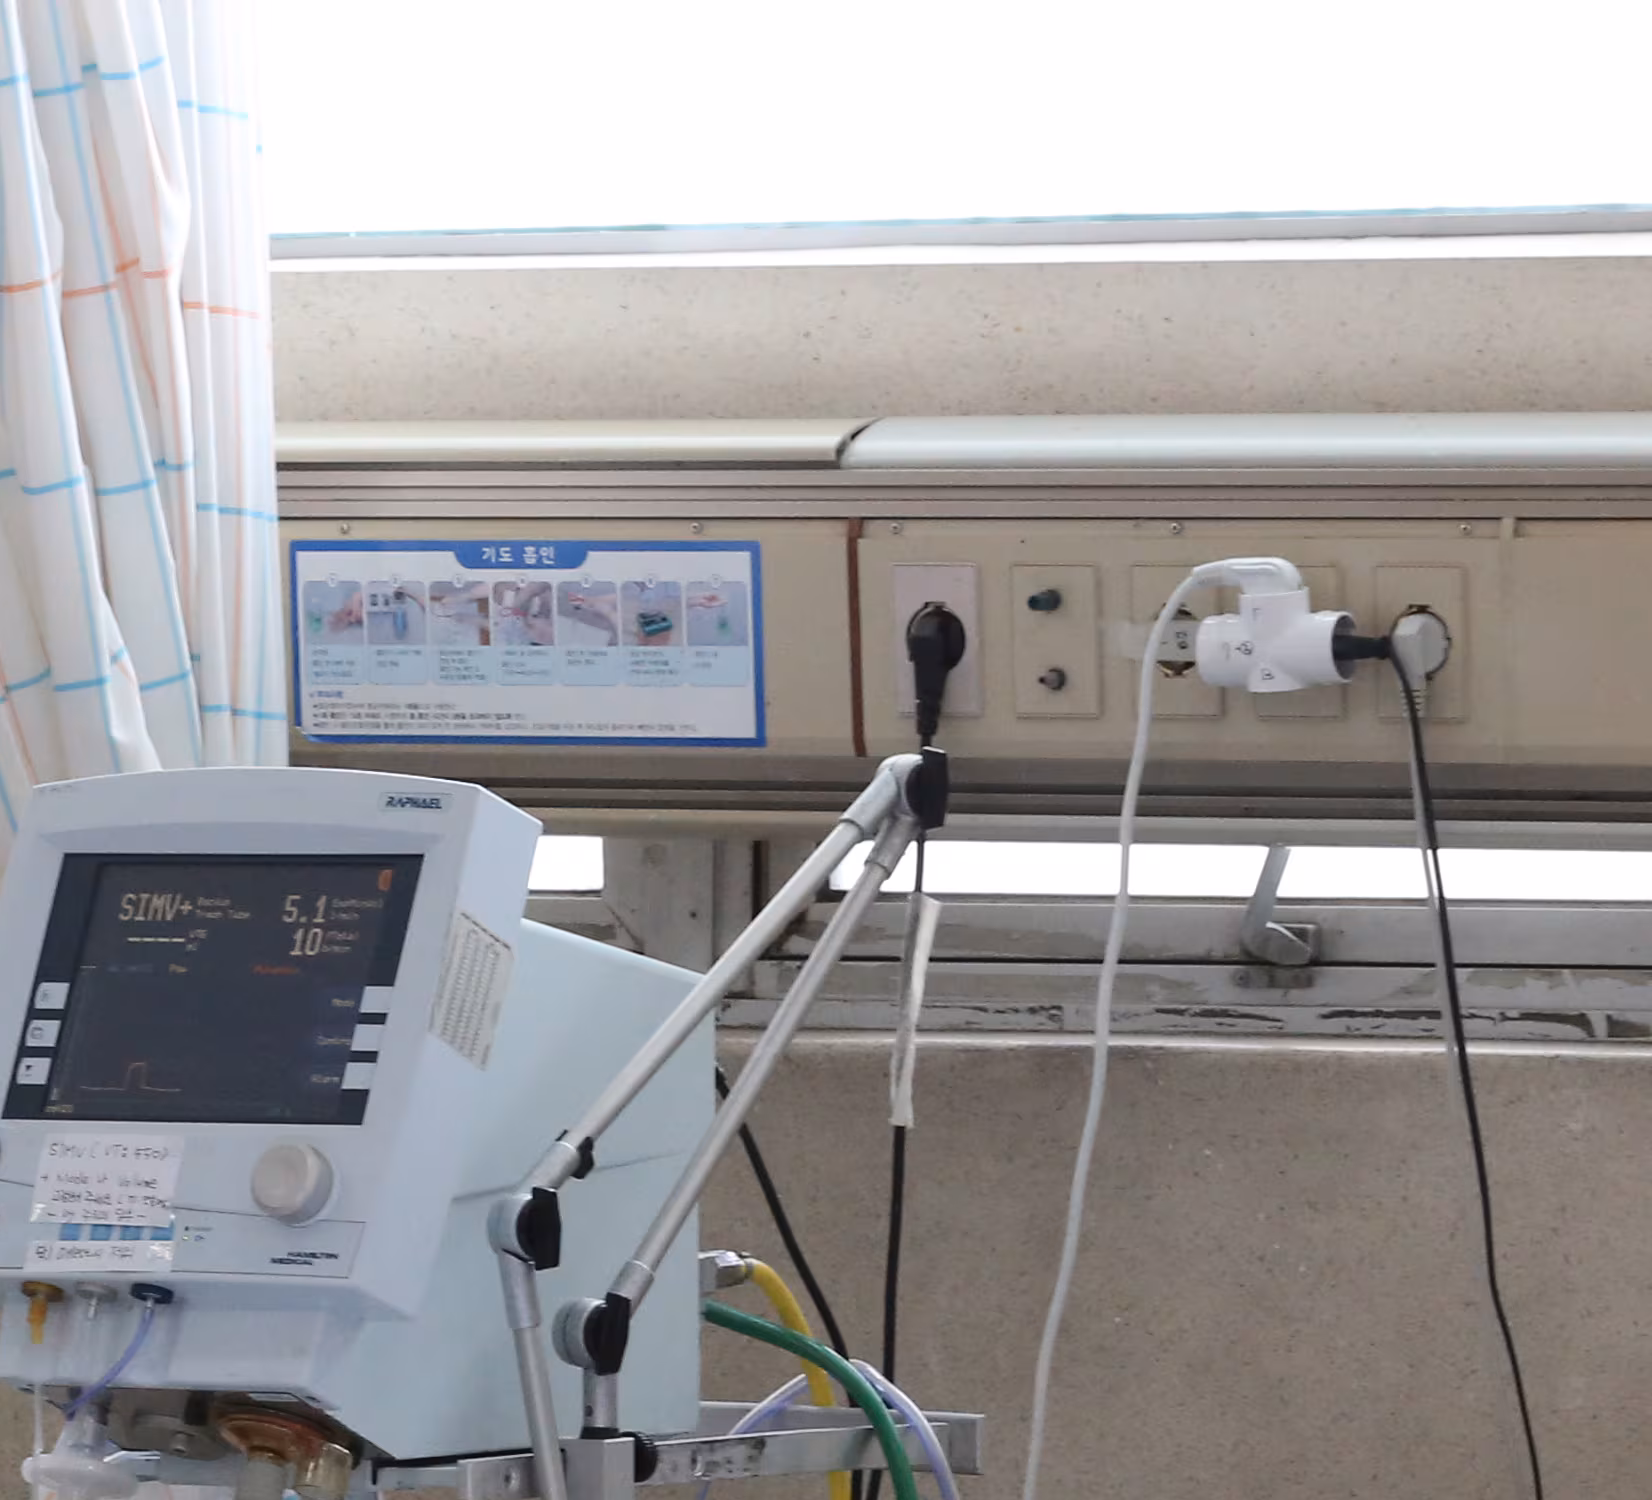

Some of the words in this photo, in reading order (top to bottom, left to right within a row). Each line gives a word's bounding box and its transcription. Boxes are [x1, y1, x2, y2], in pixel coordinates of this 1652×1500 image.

[482, 546, 513, 565] 기도
[522, 546, 557, 567] 흡인
[385, 796, 443, 809] RAPHAEL
[118, 893, 193, 921] SIMV+
[282, 895, 328, 923] 5.1
[289, 928, 323, 956] 10
